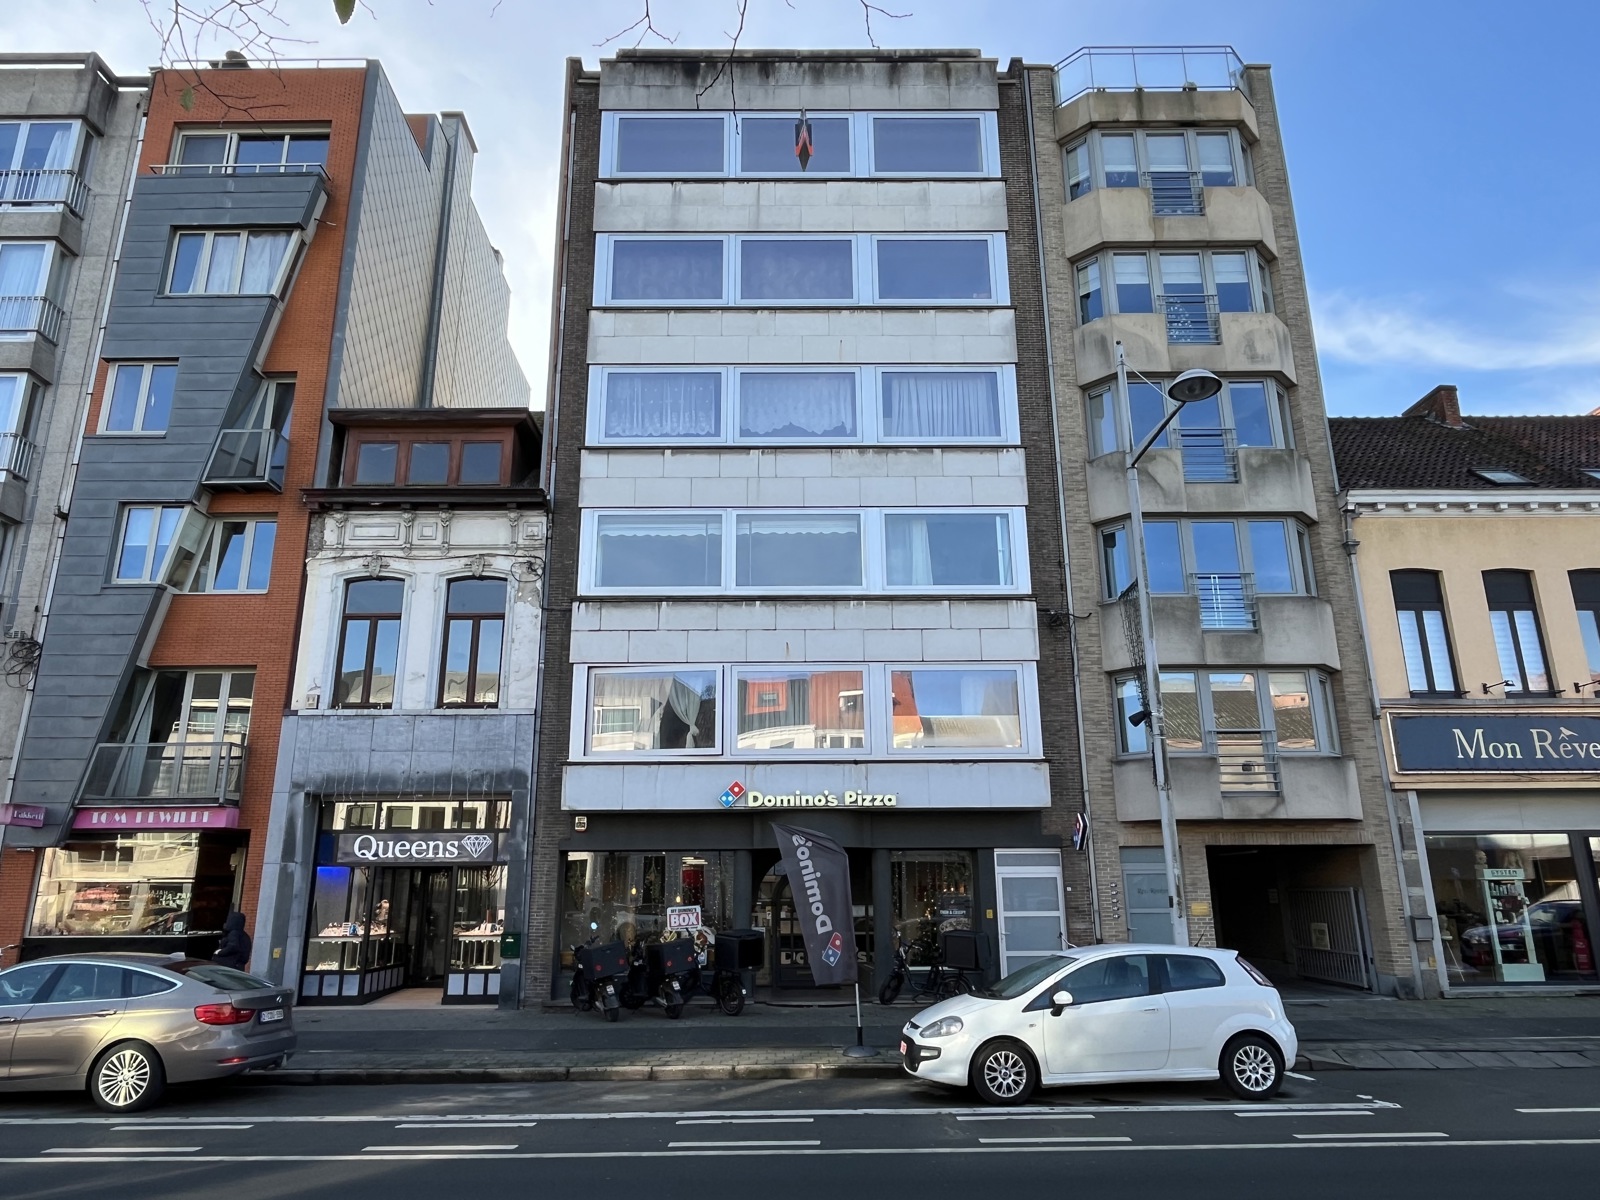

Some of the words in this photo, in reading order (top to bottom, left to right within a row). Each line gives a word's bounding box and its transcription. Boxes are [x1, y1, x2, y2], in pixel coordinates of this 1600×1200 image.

[1452, 728, 1523, 759] Mon
[1529, 727, 1600, 759] Rêve
[747, 789, 838, 807] Domino's
[844, 789, 897, 806] Pizza
[91, 811, 127, 823] TOM
[353, 834, 459, 860] Queens
[670, 912, 698, 927] BOX
